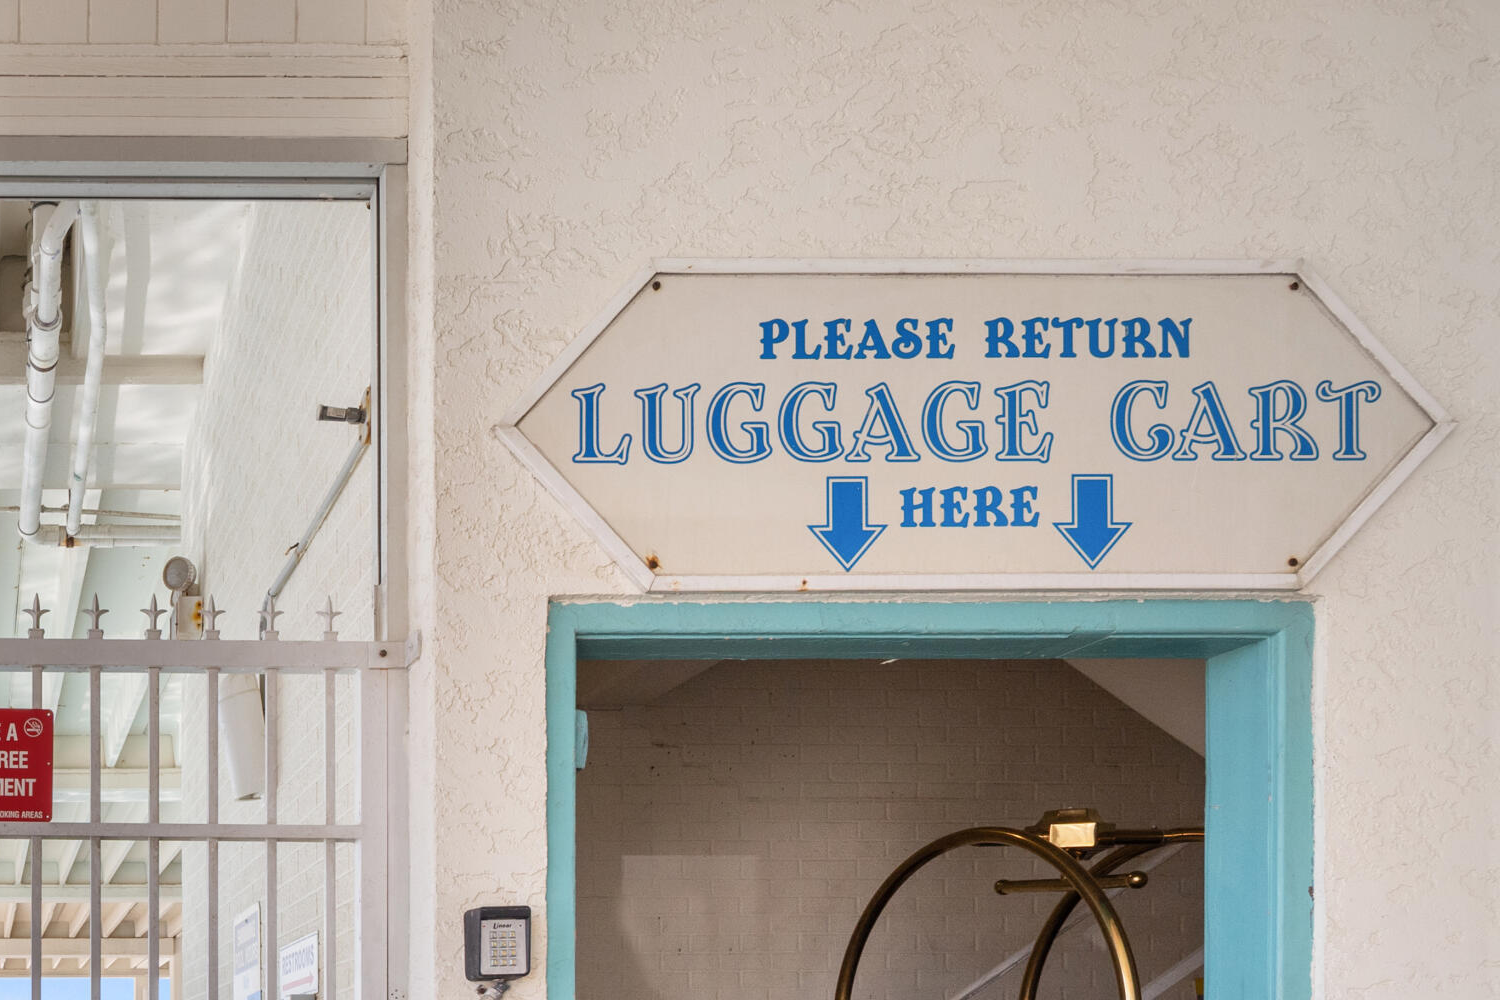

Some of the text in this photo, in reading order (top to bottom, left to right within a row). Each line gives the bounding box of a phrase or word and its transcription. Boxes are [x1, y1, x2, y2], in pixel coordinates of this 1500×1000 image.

[759, 317, 1193, 360] PLEASE RETURN
[570, 379, 1383, 465] LUGGAGE CART
[899, 485, 1041, 529] HERE
[6, 722, 18, 742] A
[21, 810, 43, 819] AREAS
[493, 922, 512, 930] Linear
[281, 943, 315, 976] RESTROOMS
